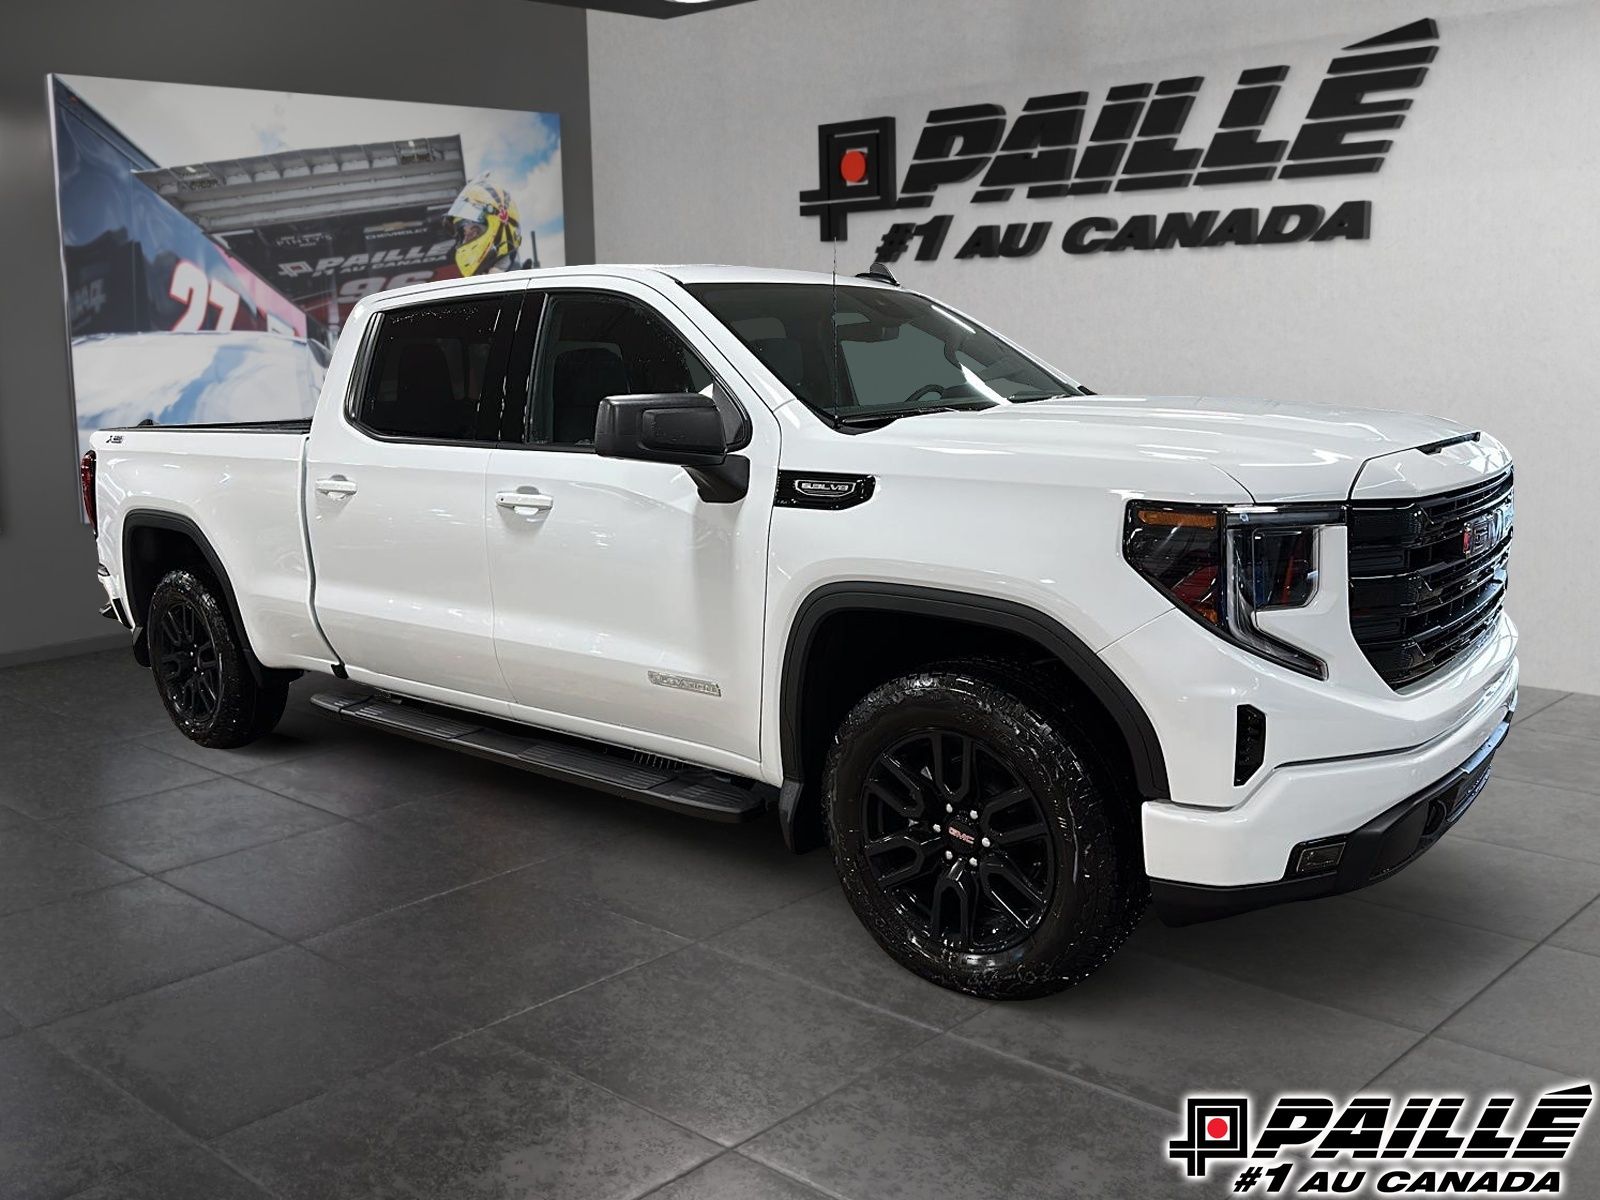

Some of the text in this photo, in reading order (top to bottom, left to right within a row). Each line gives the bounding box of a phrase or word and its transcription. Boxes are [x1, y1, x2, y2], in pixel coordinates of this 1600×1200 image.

[896, 18, 1439, 208] PAILLÉ
[875, 200, 1372, 262] #1 AU CANADA
[170, 260, 240, 331] 27
[948, 826, 975, 845] GMC
